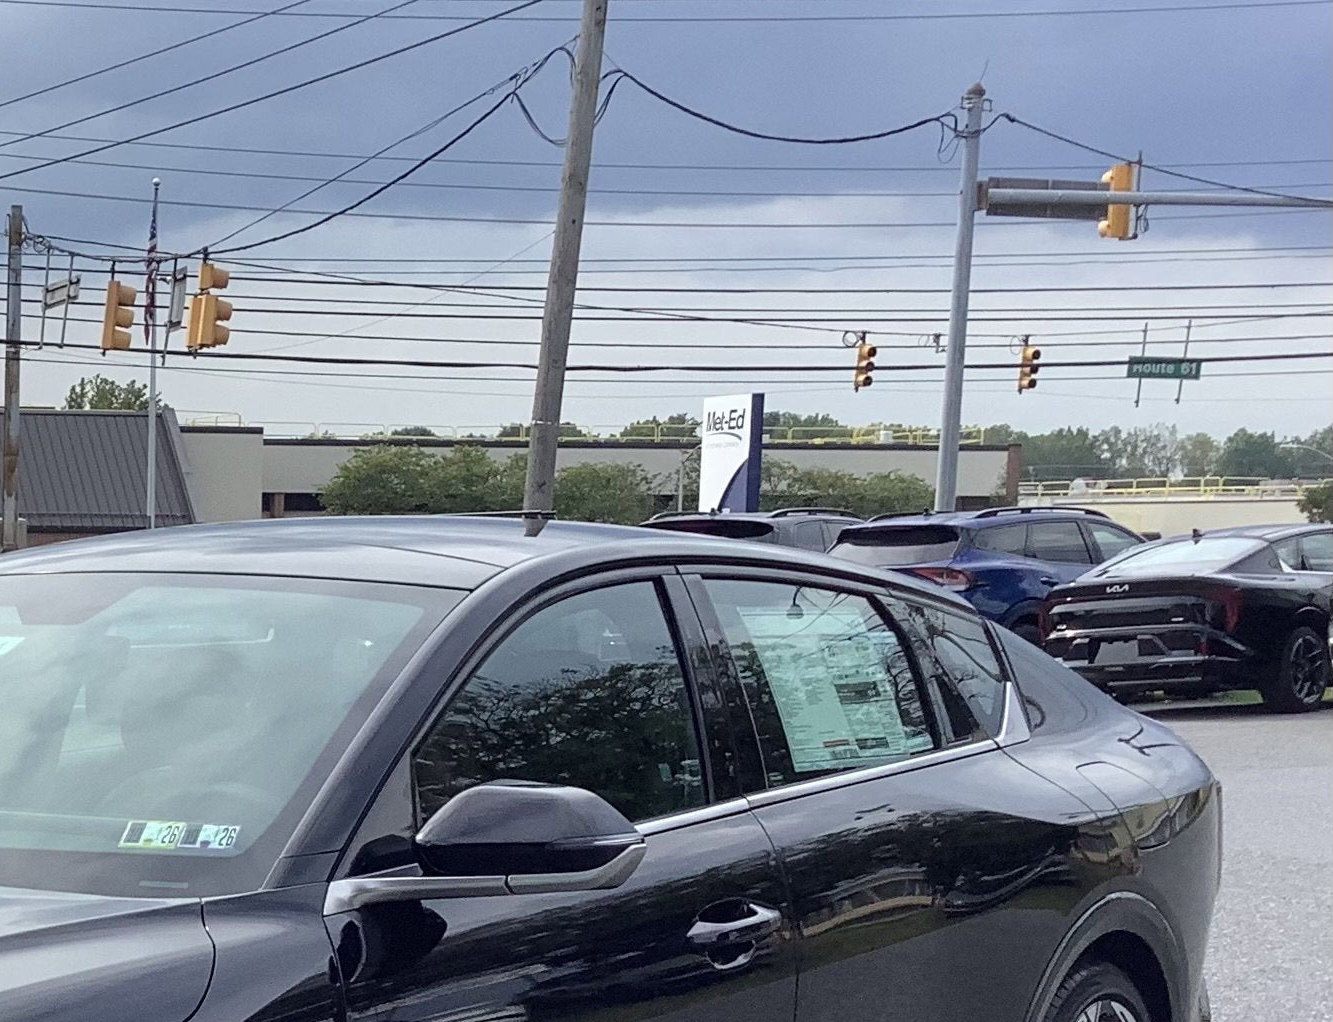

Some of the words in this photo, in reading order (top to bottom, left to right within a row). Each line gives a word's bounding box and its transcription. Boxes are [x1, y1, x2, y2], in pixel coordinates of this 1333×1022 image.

[1132, 362, 1175, 374] Route
[706, 408, 746, 432] Met-Ed
[1106, 584, 1129, 593] KIA
[161, 825, 180, 844] 26
[218, 827, 237, 847] 26
